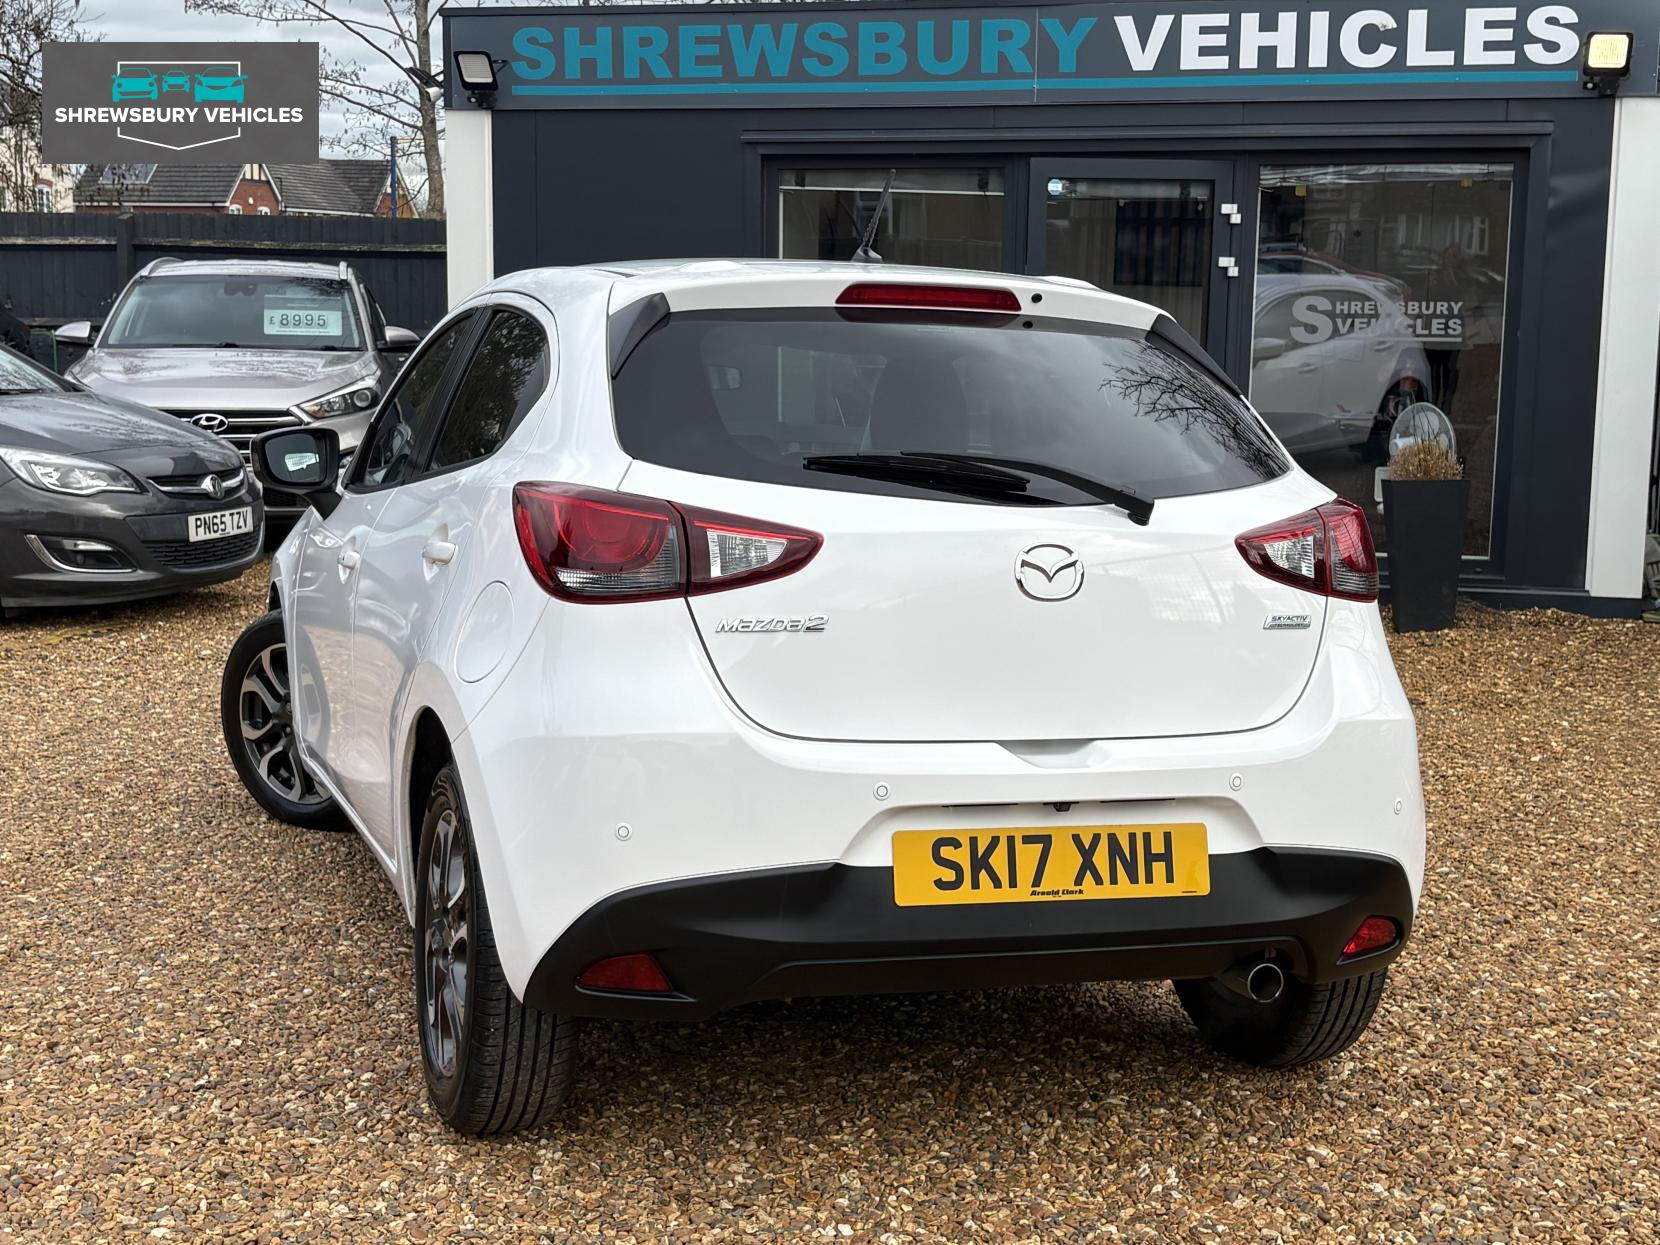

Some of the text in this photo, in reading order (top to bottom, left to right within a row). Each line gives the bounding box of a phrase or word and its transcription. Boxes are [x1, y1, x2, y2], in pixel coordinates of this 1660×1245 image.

[511, 5, 1580, 80] SHREWSBURY VEHICLES
[194, 509, 248, 537] PN65 TZV
[931, 831, 1175, 891] SK17 XNH
